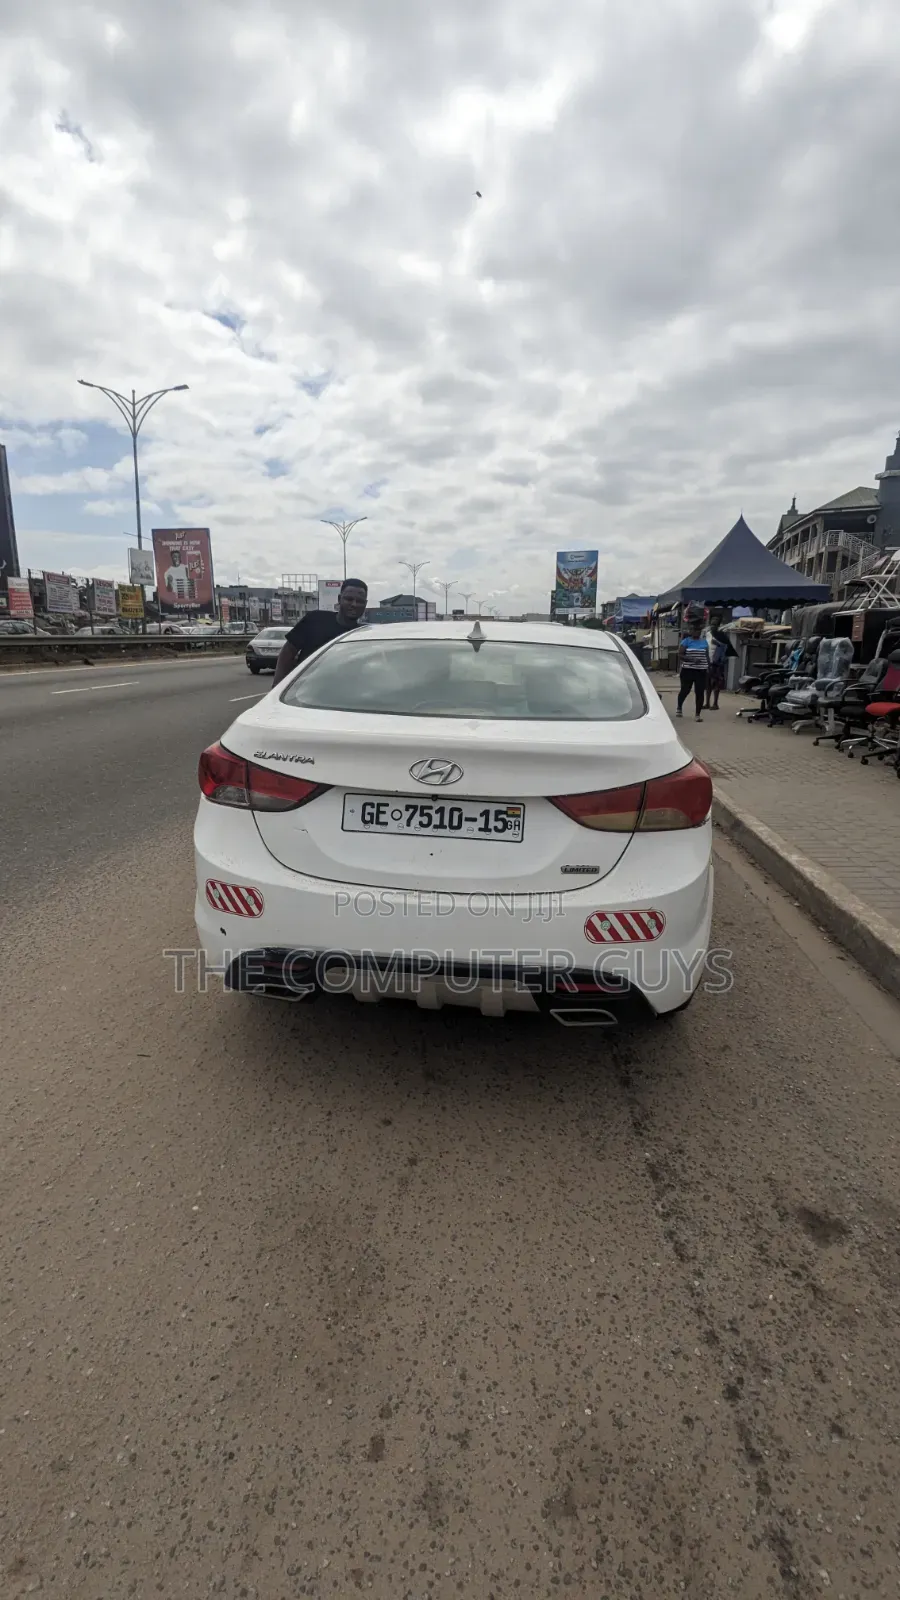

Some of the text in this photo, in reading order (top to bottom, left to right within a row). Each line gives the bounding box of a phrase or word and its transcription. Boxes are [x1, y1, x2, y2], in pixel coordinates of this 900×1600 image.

[254, 751, 315, 765] ELANTRA
[361, 802, 507, 833] GE 7510-15
